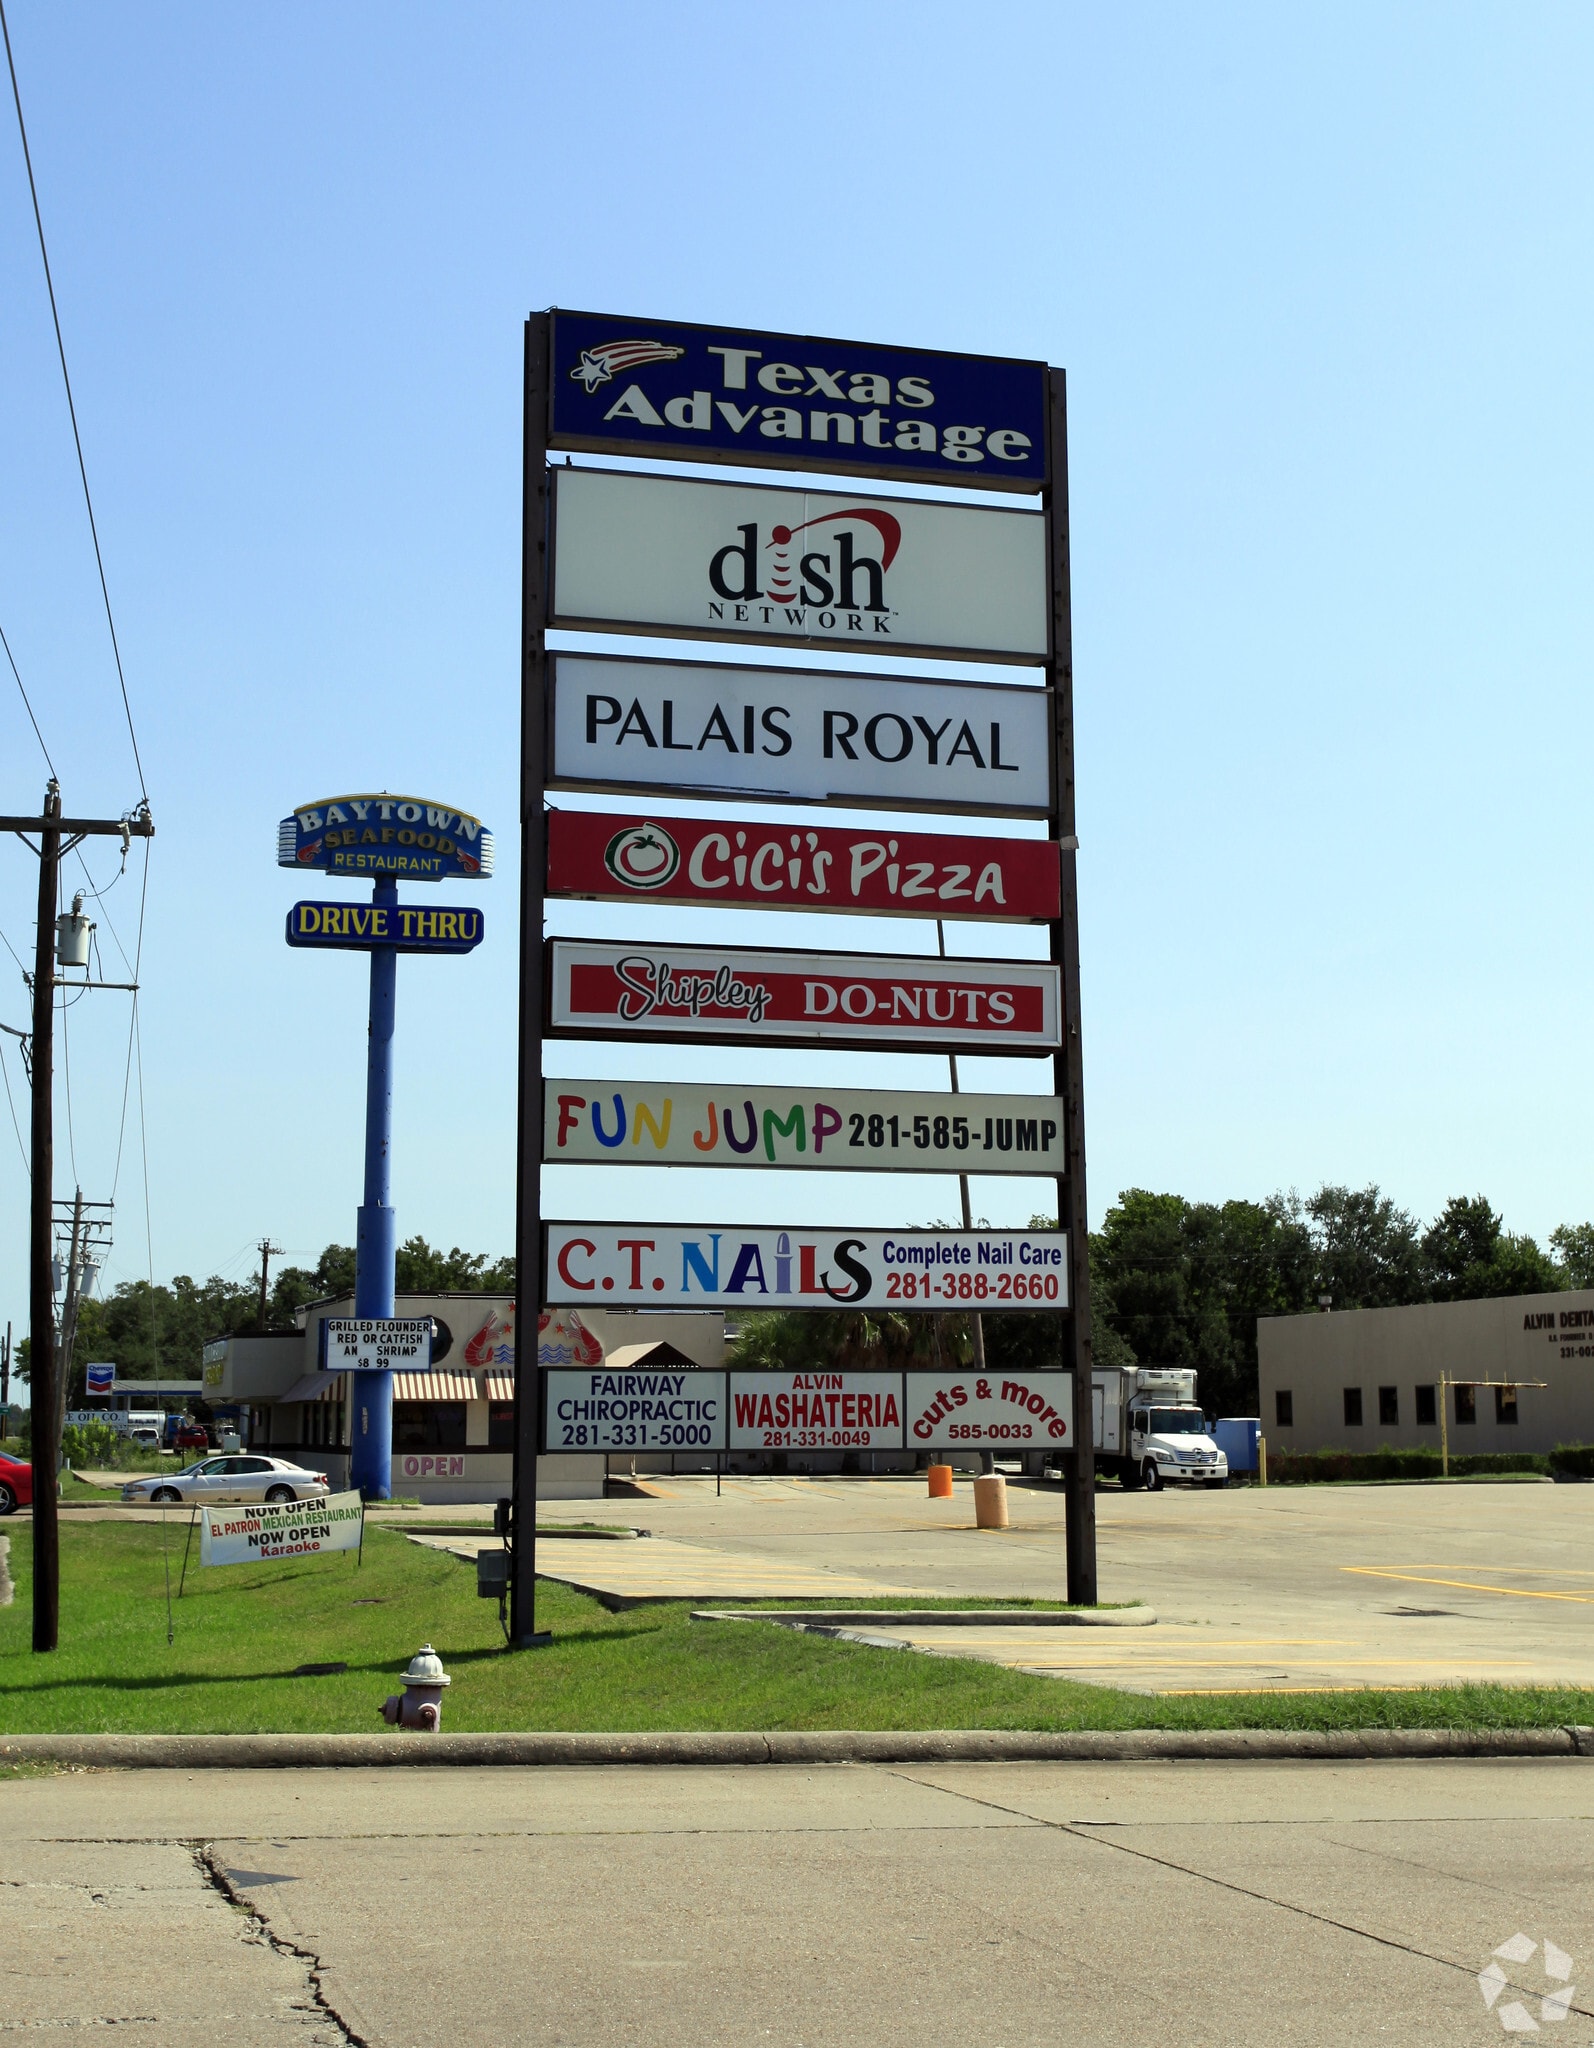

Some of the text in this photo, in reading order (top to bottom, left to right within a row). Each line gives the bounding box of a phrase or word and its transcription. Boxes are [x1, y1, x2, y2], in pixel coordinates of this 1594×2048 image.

[707, 346, 935, 408] Texas
[603, 384, 1032, 463] Advantage
[709, 521, 890, 612] dish
[708, 602, 891, 633] NETWORK
[586, 694, 1019, 771] PALAIS ROYAL
[298, 801, 481, 841] BAYTOWN
[324, 828, 457, 855] SEAFOOD
[335, 853, 441, 872] RESTAURANT
[299, 906, 478, 939] DRIVE THRU
[614, 956, 1016, 1024] Shipley DO-NUTS
[557, 1093, 1057, 1162] FUN JUMP 281-585-JUMP
[557, 1238, 665, 1291] C.T.
[883, 1240, 1062, 1269] Complete Nail Care
[886, 1272, 1059, 1301] 281-388-2660
[329, 1321, 429, 1332] GRILLED FLOUNDER
[1524, 1313, 1555, 1330] ALVIN
[337, 1333, 422, 1344] RED OR CATFISH
[344, 1346, 417, 1356] AN SHRIMP
[376, 1358, 389, 1368] 99
[591, 1375, 685, 1396] FAIRWAY
[792, 1374, 843, 1390] ALVIN
[557, 1400, 717, 1421] CHIROPRACTIC
[735, 1394, 900, 1429] WASHATERIA
[913, 1378, 1067, 1440] cuts & more
[562, 1425, 712, 1446] 281-331-5000
[763, 1431, 871, 1447] 281-331-0049
[948, 1424, 1032, 1440] 585-0033
[404, 1456, 463, 1476] OPEN
[245, 1498, 327, 1518] NOW OPEN
[211, 1507, 361, 1537] EL PATRON MEXICAN RESTAURANT
[248, 1525, 331, 1547] NOW OPEN
[261, 1540, 320, 1557] Karaoke
